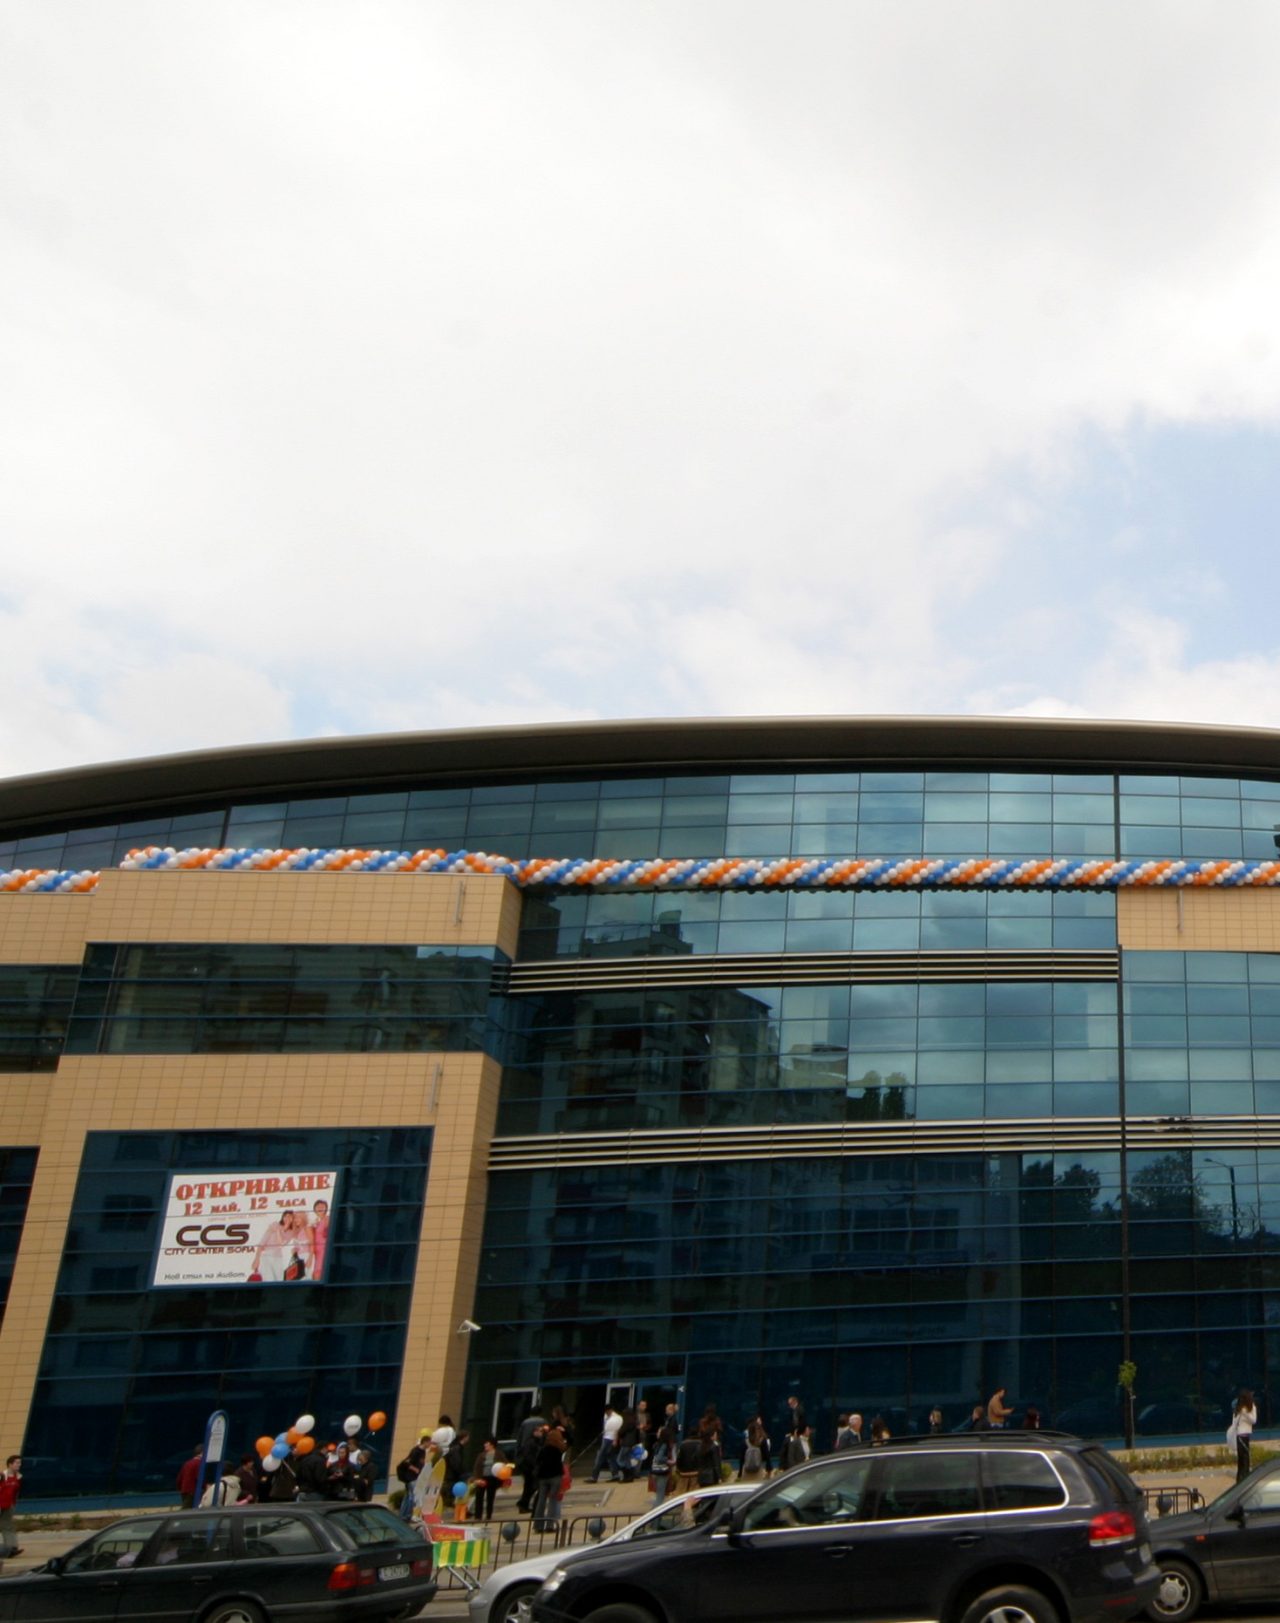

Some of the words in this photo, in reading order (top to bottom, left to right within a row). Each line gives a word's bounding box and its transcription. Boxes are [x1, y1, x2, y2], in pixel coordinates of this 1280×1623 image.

[176, 1174, 331, 1200] ОТКРИВАНЕ
[184, 1202, 203, 1216] 12
[250, 1197, 268, 1210] 12
[276, 1199, 306, 1208] ЧАСА
[176, 1224, 250, 1246] CCS
[164, 1247, 184, 1256] CITY
[188, 1247, 224, 1255] CENTER
[226, 1246, 256, 1254] SOFIA
